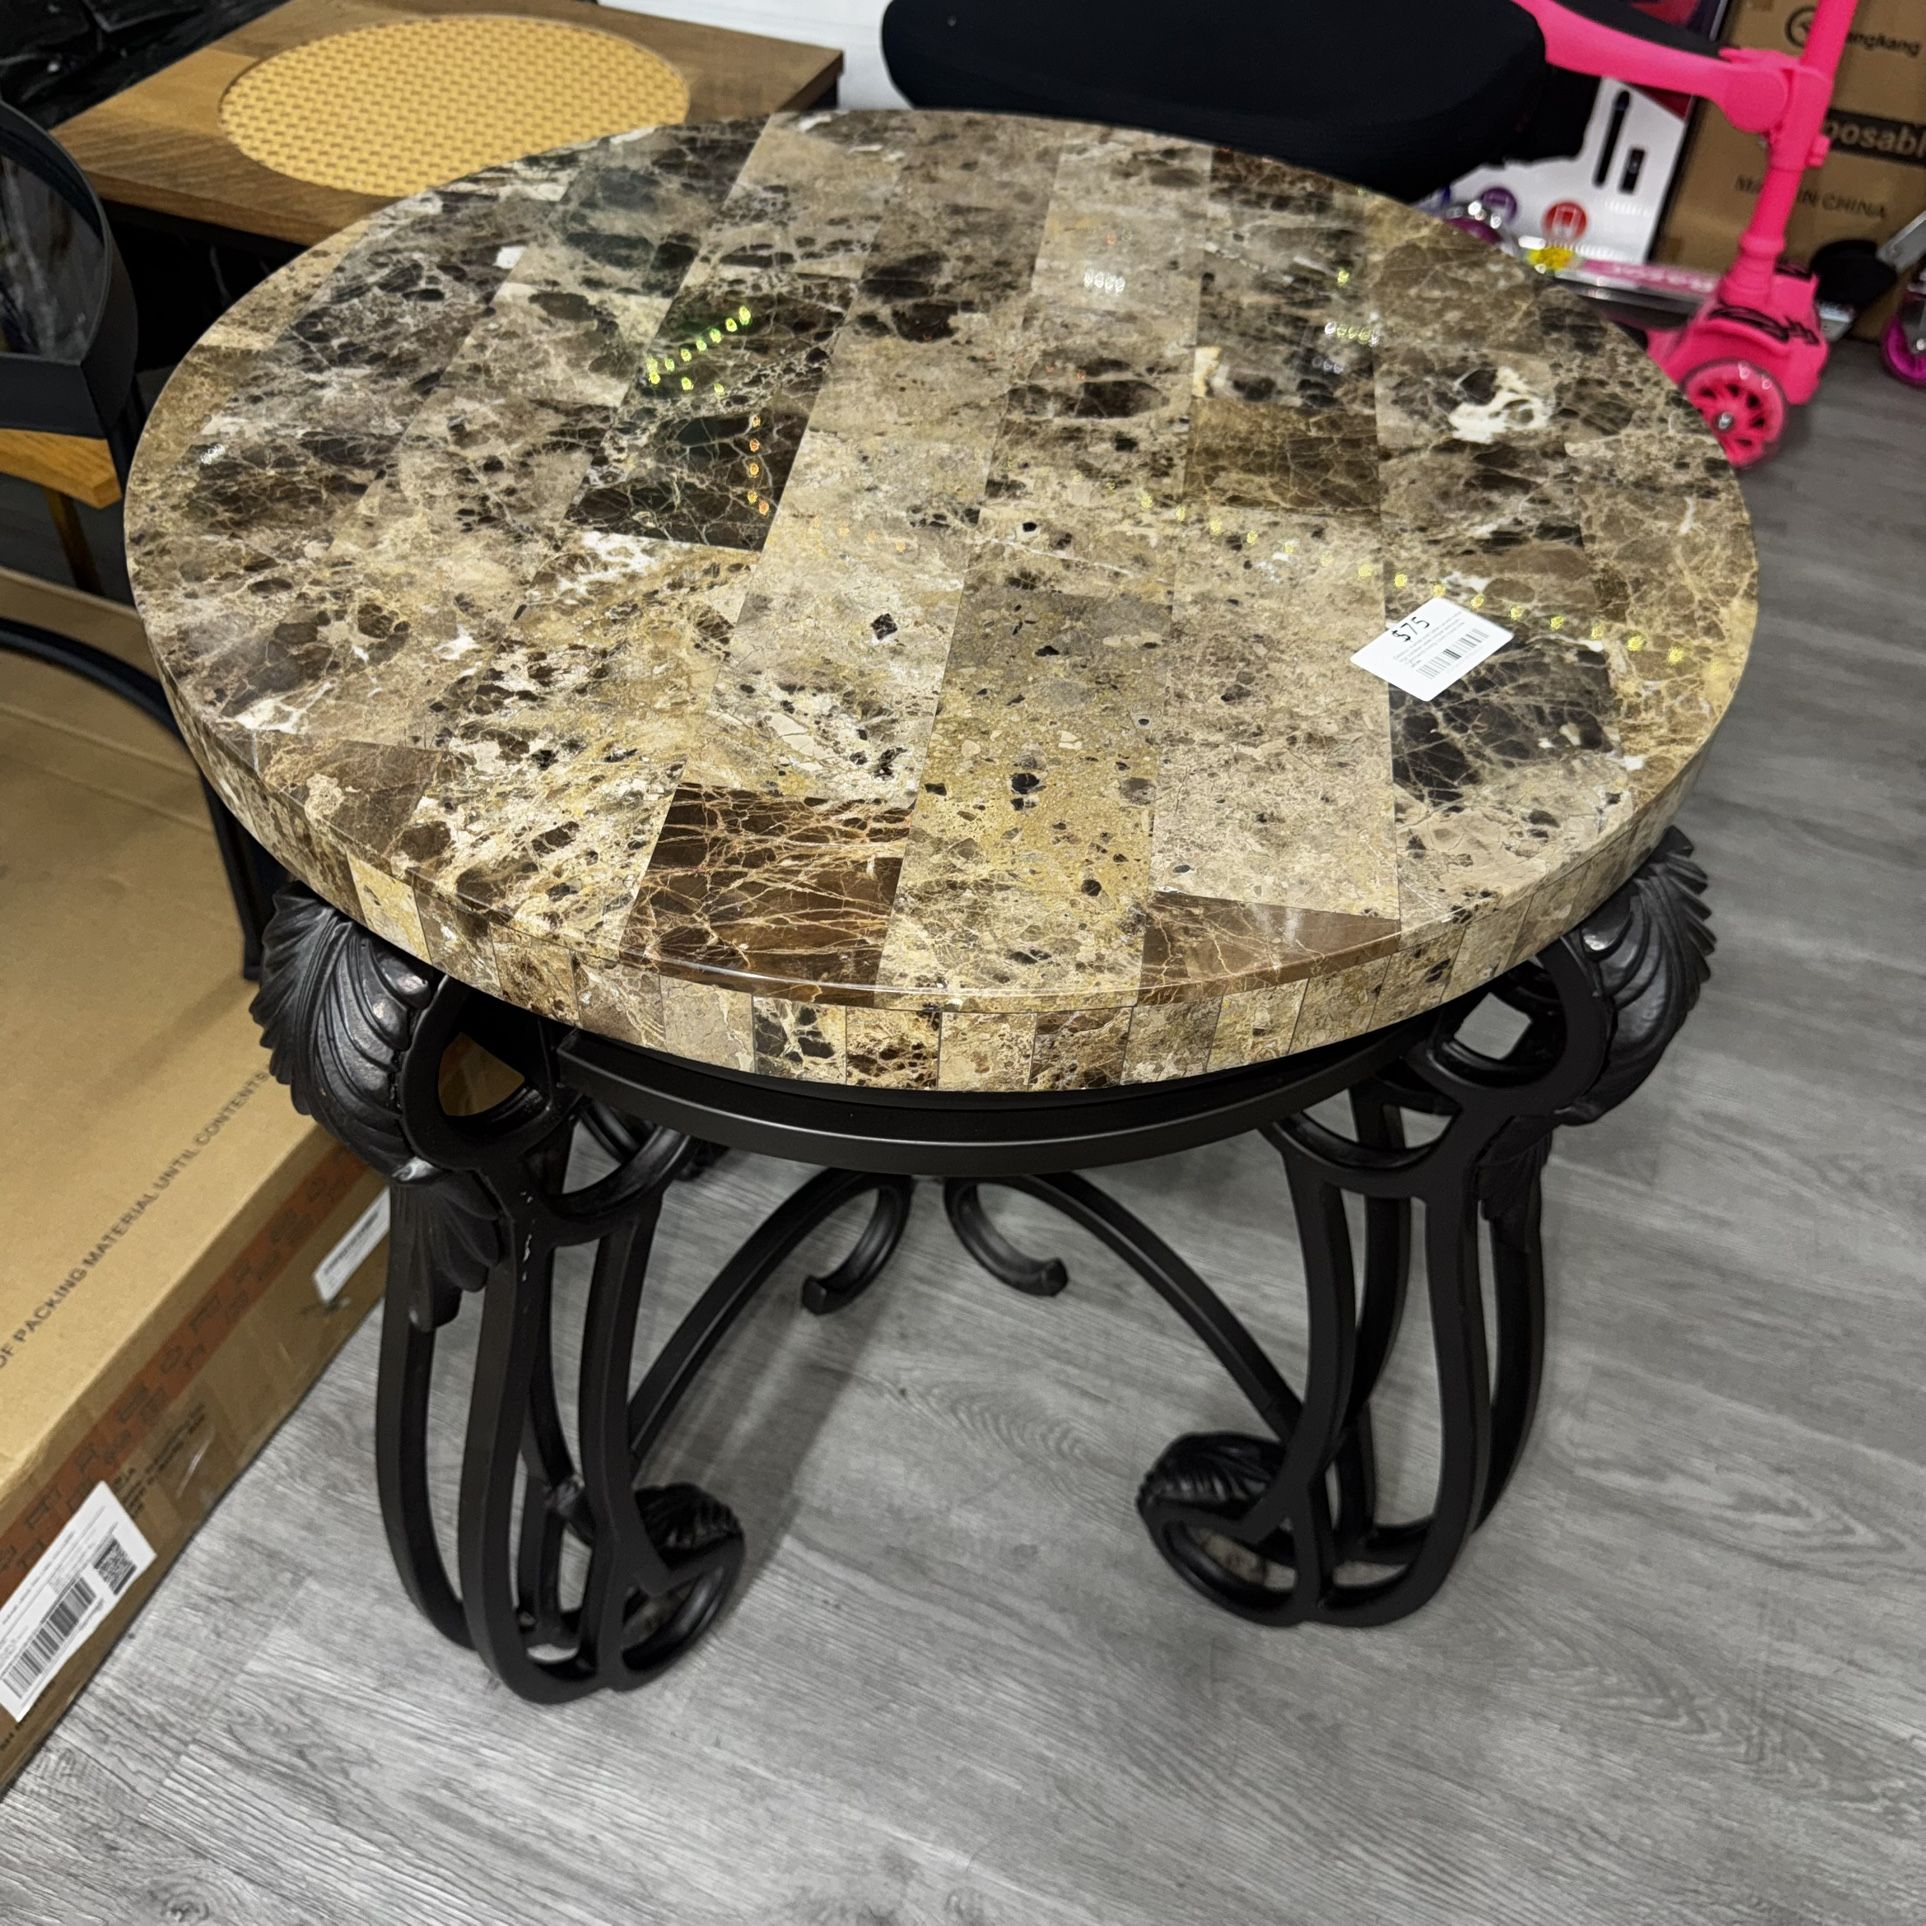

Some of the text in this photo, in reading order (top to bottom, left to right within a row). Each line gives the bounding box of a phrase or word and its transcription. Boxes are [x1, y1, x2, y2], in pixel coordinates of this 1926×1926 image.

[1823, 120, 1926, 159] posabl
[1822, 191, 1888, 219] CHINA
[13, 1267, 88, 1342] PACKING
[82, 1193, 160, 1268] MATERIAL
[153, 1148, 200, 1190] UNTIL
[192, 1071, 269, 1146] CONTENTS
